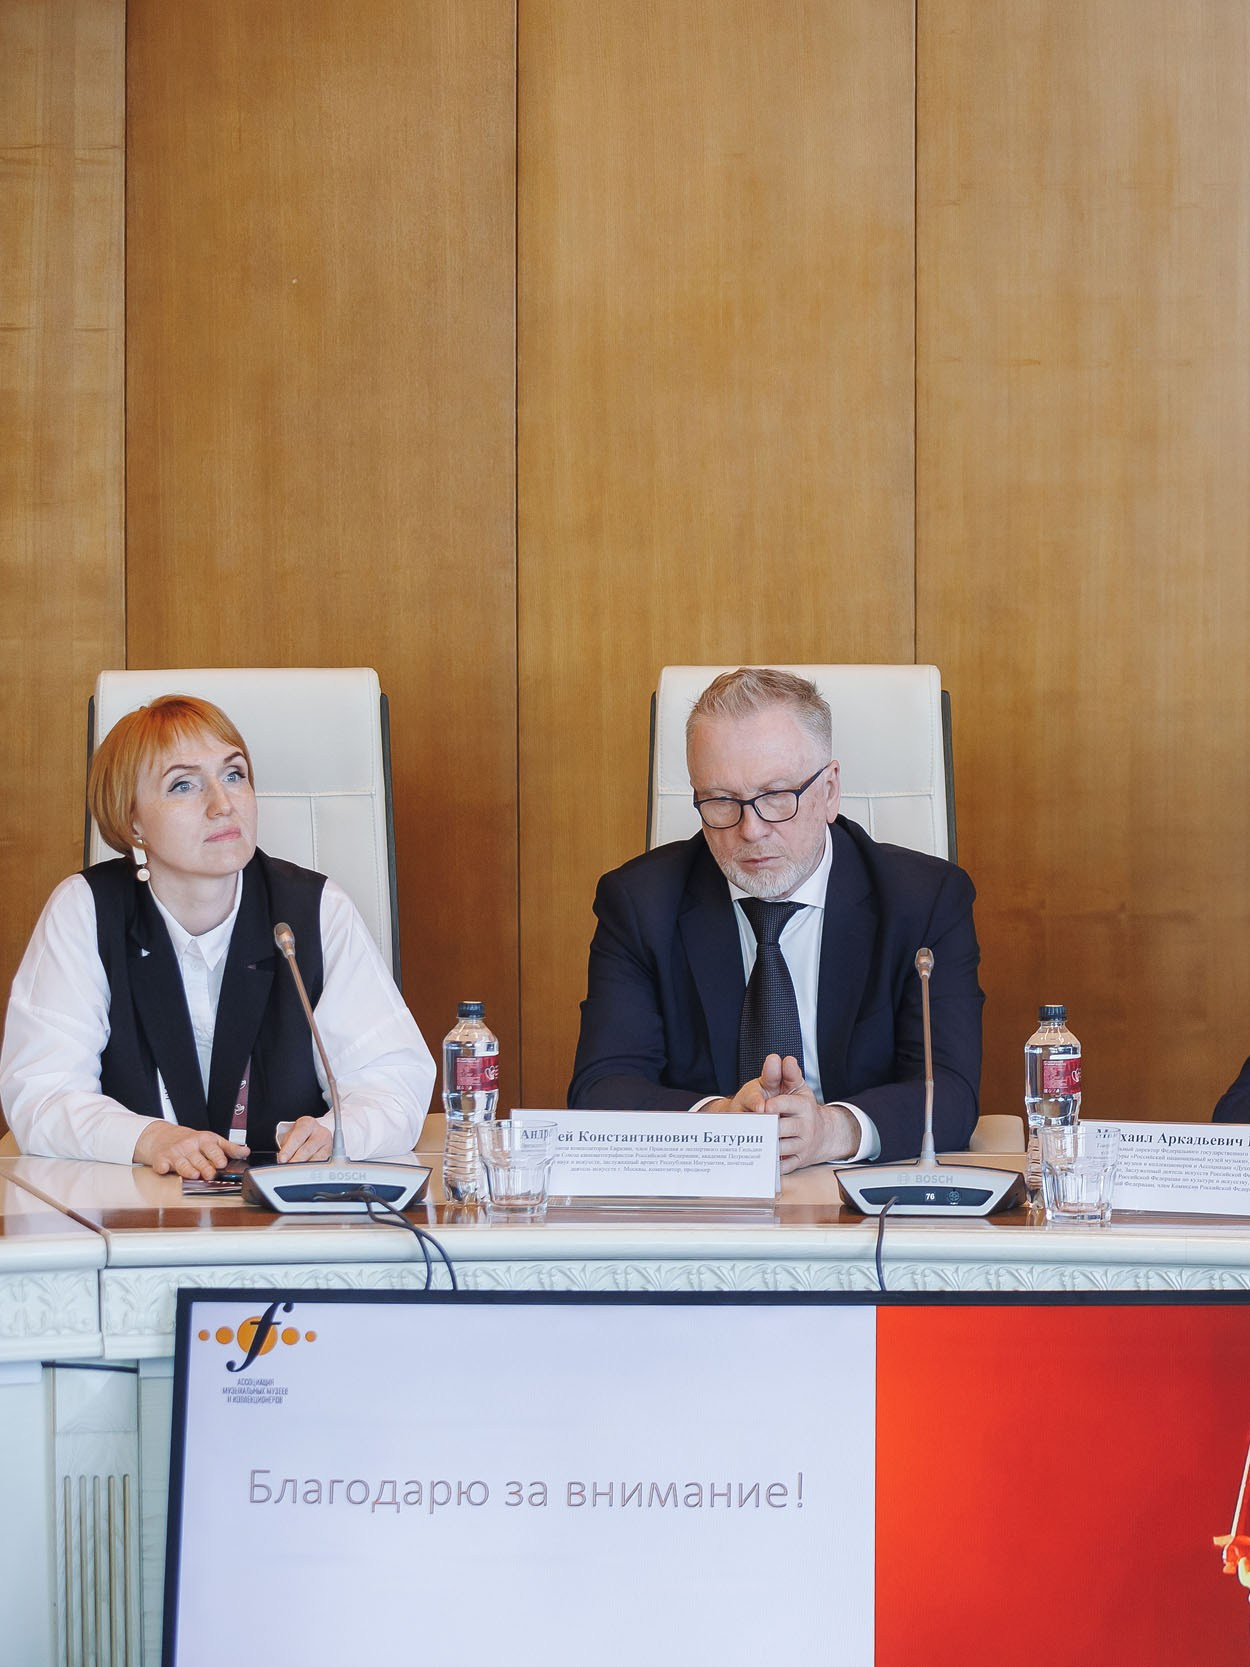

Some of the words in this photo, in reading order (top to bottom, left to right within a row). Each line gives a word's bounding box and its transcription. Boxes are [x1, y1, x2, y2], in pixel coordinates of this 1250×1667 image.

[579, 1130, 698, 1143] Константинович
[703, 1131, 763, 1146] Батурин
[1157, 1132, 1243, 1147] Аркадьевич
[329, 1172, 367, 1181] BOSCH
[915, 1174, 954, 1184] BOSCH
[249, 1469, 490, 1514] Благодарю
[504, 1479, 549, 1508] за
[566, 1472, 804, 1509] внимание!
